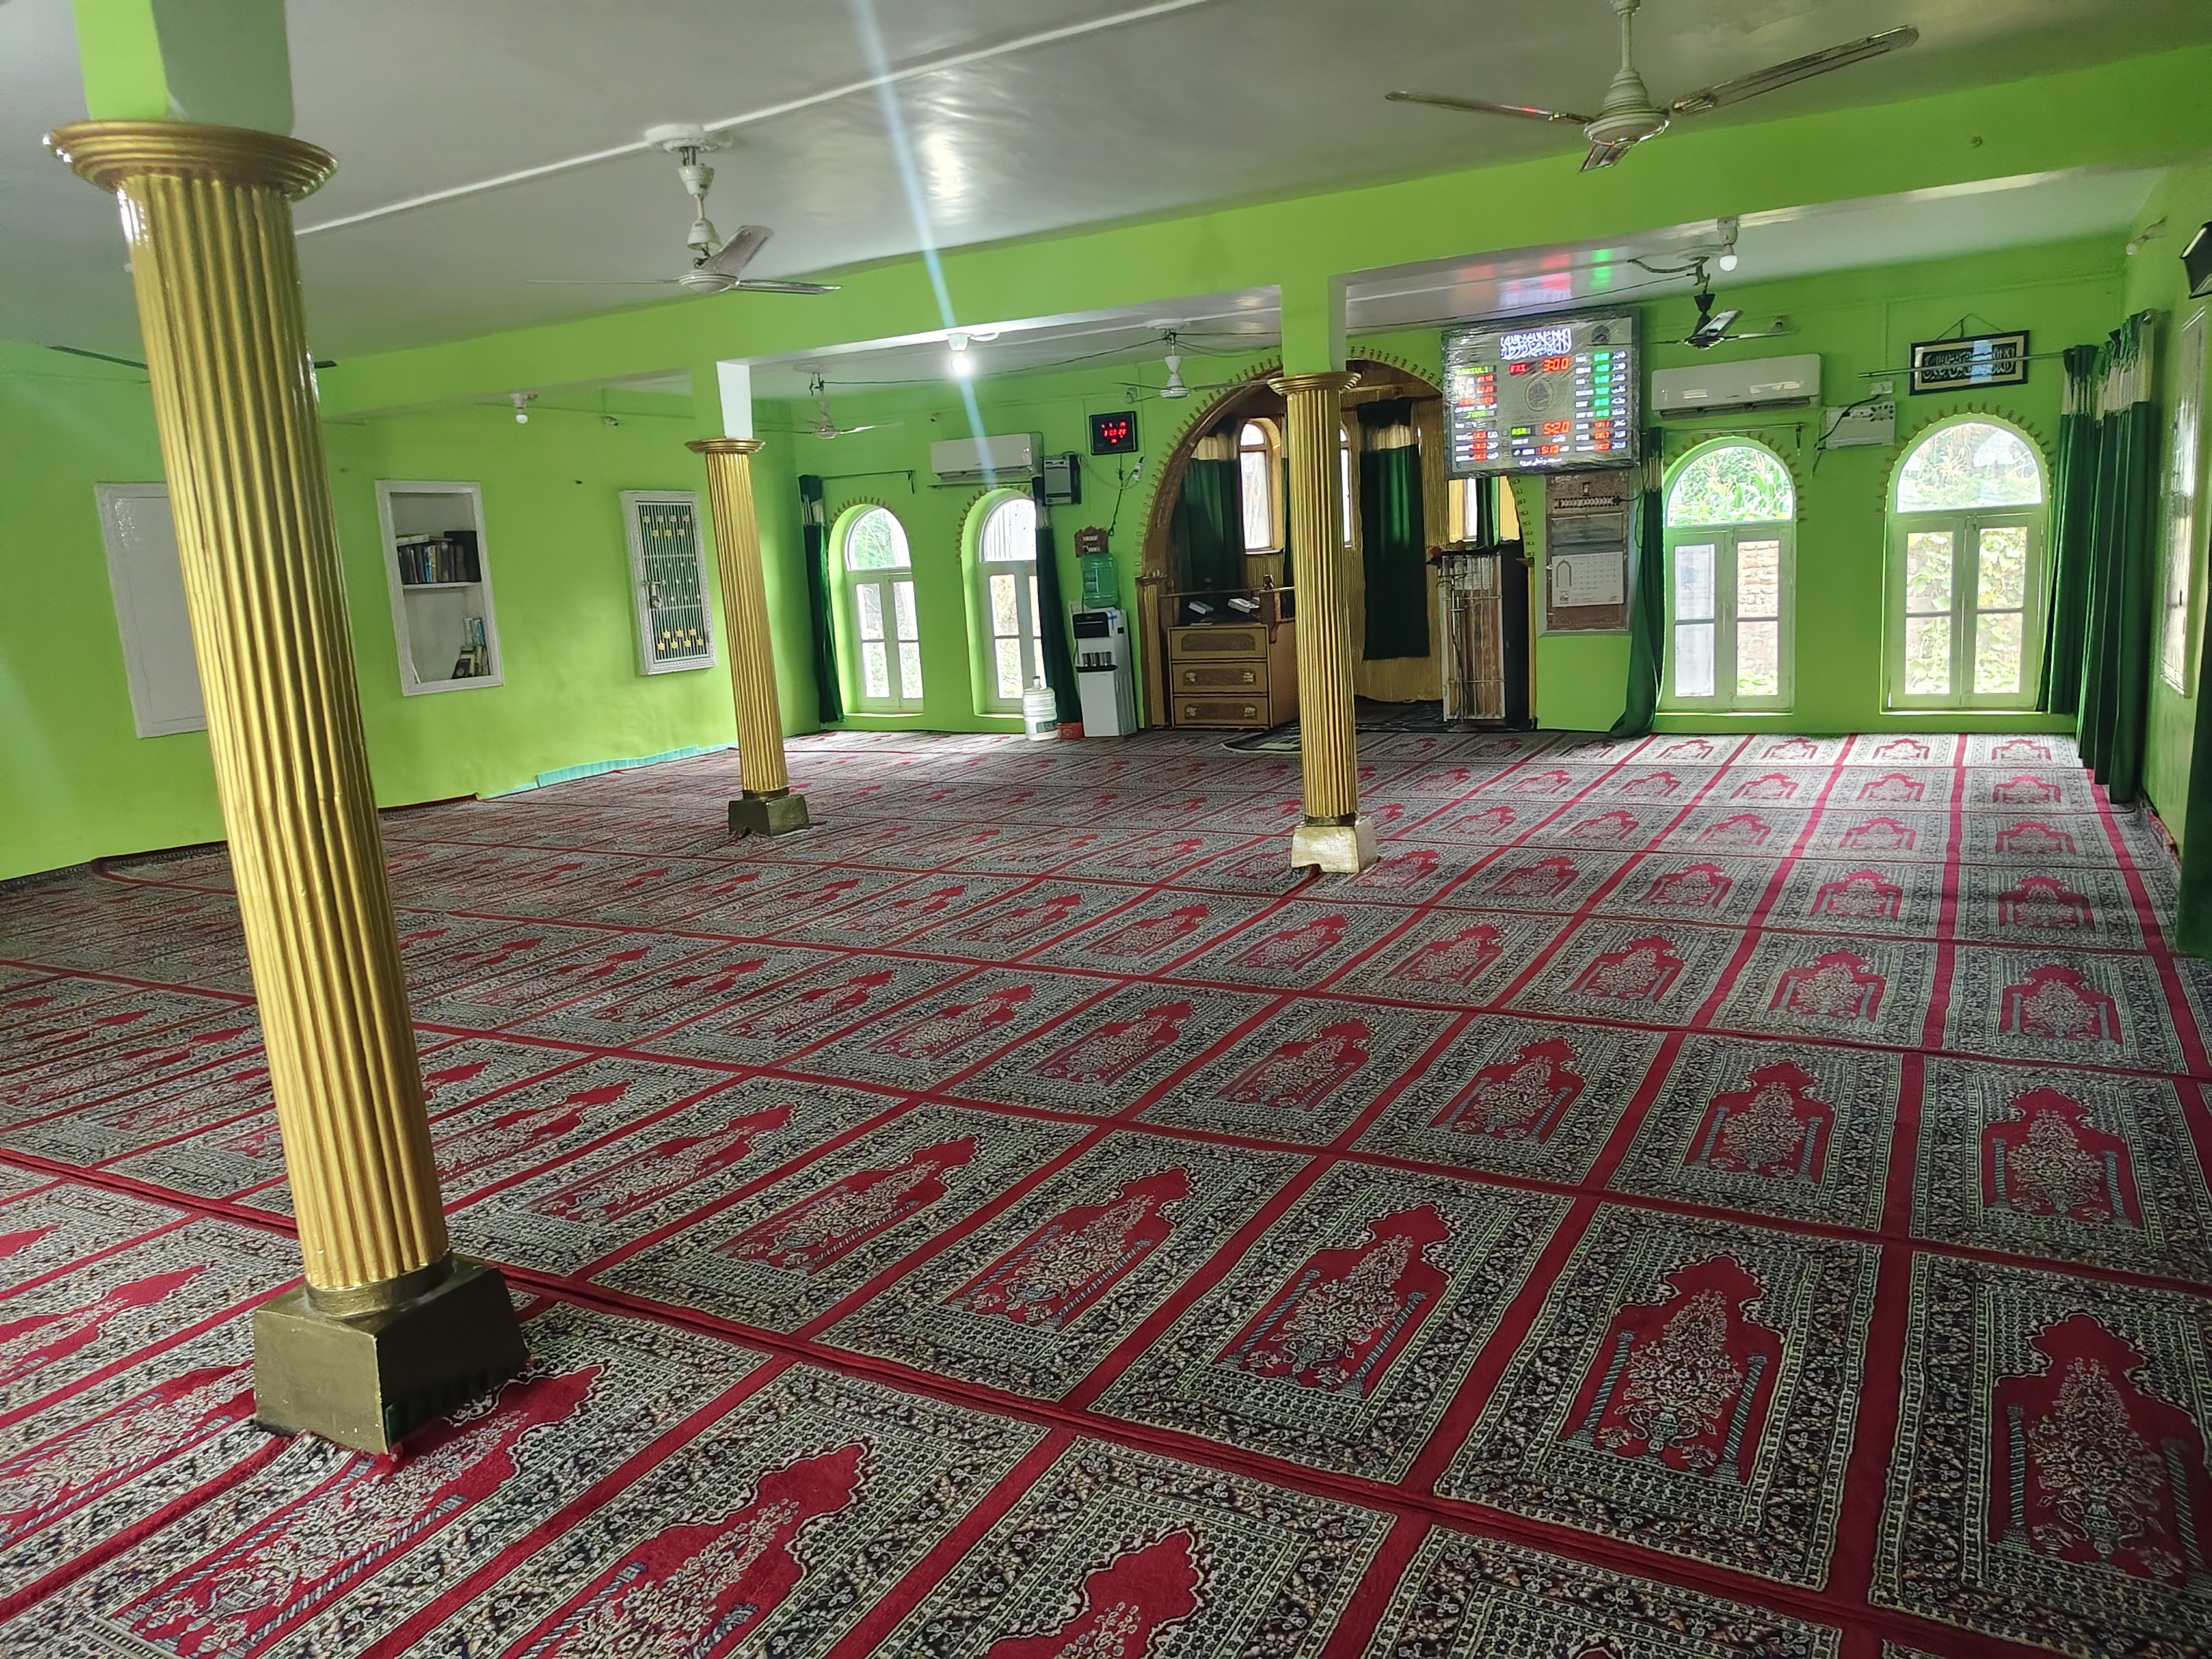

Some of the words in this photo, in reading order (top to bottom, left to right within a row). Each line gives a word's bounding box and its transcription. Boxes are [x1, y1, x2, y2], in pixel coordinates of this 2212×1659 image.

[1510, 364, 1526, 373] FRI
[1543, 357, 1569, 372] 3:00
[1512, 427, 1527, 435] ASR
[1543, 421, 1570, 435] 5:20
